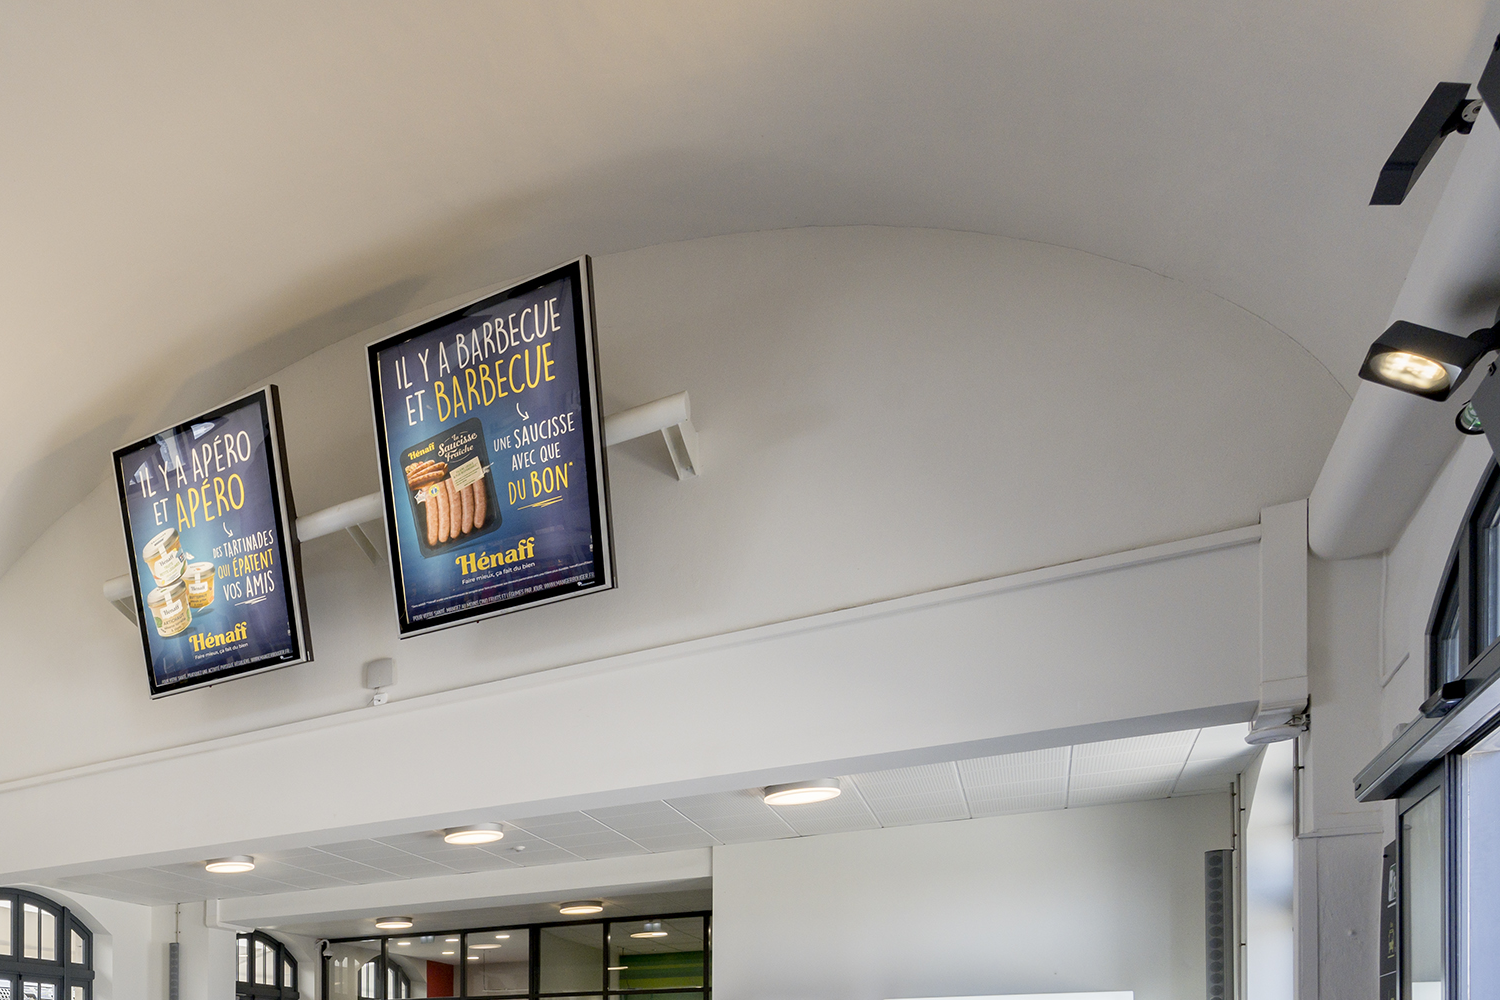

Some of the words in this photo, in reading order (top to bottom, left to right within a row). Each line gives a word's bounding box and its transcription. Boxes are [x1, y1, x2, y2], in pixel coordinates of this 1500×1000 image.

[395, 355, 412, 390] IL
[418, 349, 430, 382] Y
[439, 341, 451, 377] A
[456, 297, 561, 370] BARBECUE
[406, 389, 426, 426] ET
[435, 342, 556, 422] BARBECUE
[438, 433, 478, 457] Saucisse
[493, 435, 511, 452] UNE
[513, 412, 575, 449] SAUCISSE
[139, 467, 156, 499] IL
[159, 465, 170, 493] Y
[176, 454, 188, 488] A
[192, 430, 251, 483] APÉRO
[408, 442, 435, 460] Hénaff
[511, 449, 536, 472] AVEC
[540, 441, 560, 462] QUE
[153, 497, 169, 526] ET
[176, 473, 245, 533] APÉRO
[508, 480, 527, 505] DU
[213, 545, 223, 559] DES
[223, 530, 275, 558] TARTINADES
[455, 536, 536, 577] Hénaff
[218, 562, 231, 580] QUI
[232, 548, 274, 579] ÉPATENT
[461, 576, 475, 585] Faire
[476, 570, 494, 582] mieux,
[495, 569, 502, 577] ça
[503, 566, 512, 574] fait
[512, 564, 521, 572] du
[522, 560, 535, 570] bien
[223, 580, 243, 601] VOS
[246, 570, 275, 598] AMIS
[189, 621, 248, 653] Hénaff
